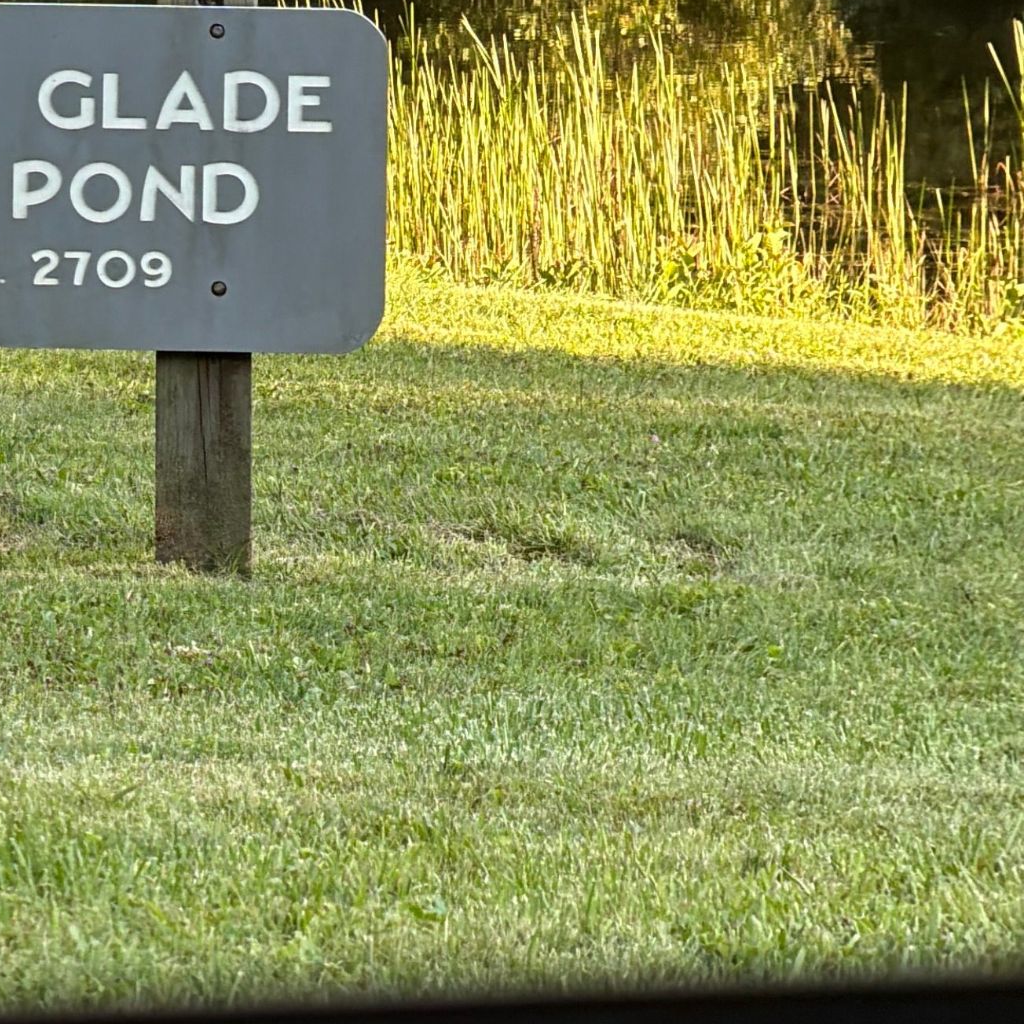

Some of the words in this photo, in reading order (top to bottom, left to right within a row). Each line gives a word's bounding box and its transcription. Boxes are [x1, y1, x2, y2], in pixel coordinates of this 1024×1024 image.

[38, 70, 332, 133] GLADE
[12, 160, 259, 225] POND
[31, 249, 172, 288] 2709
